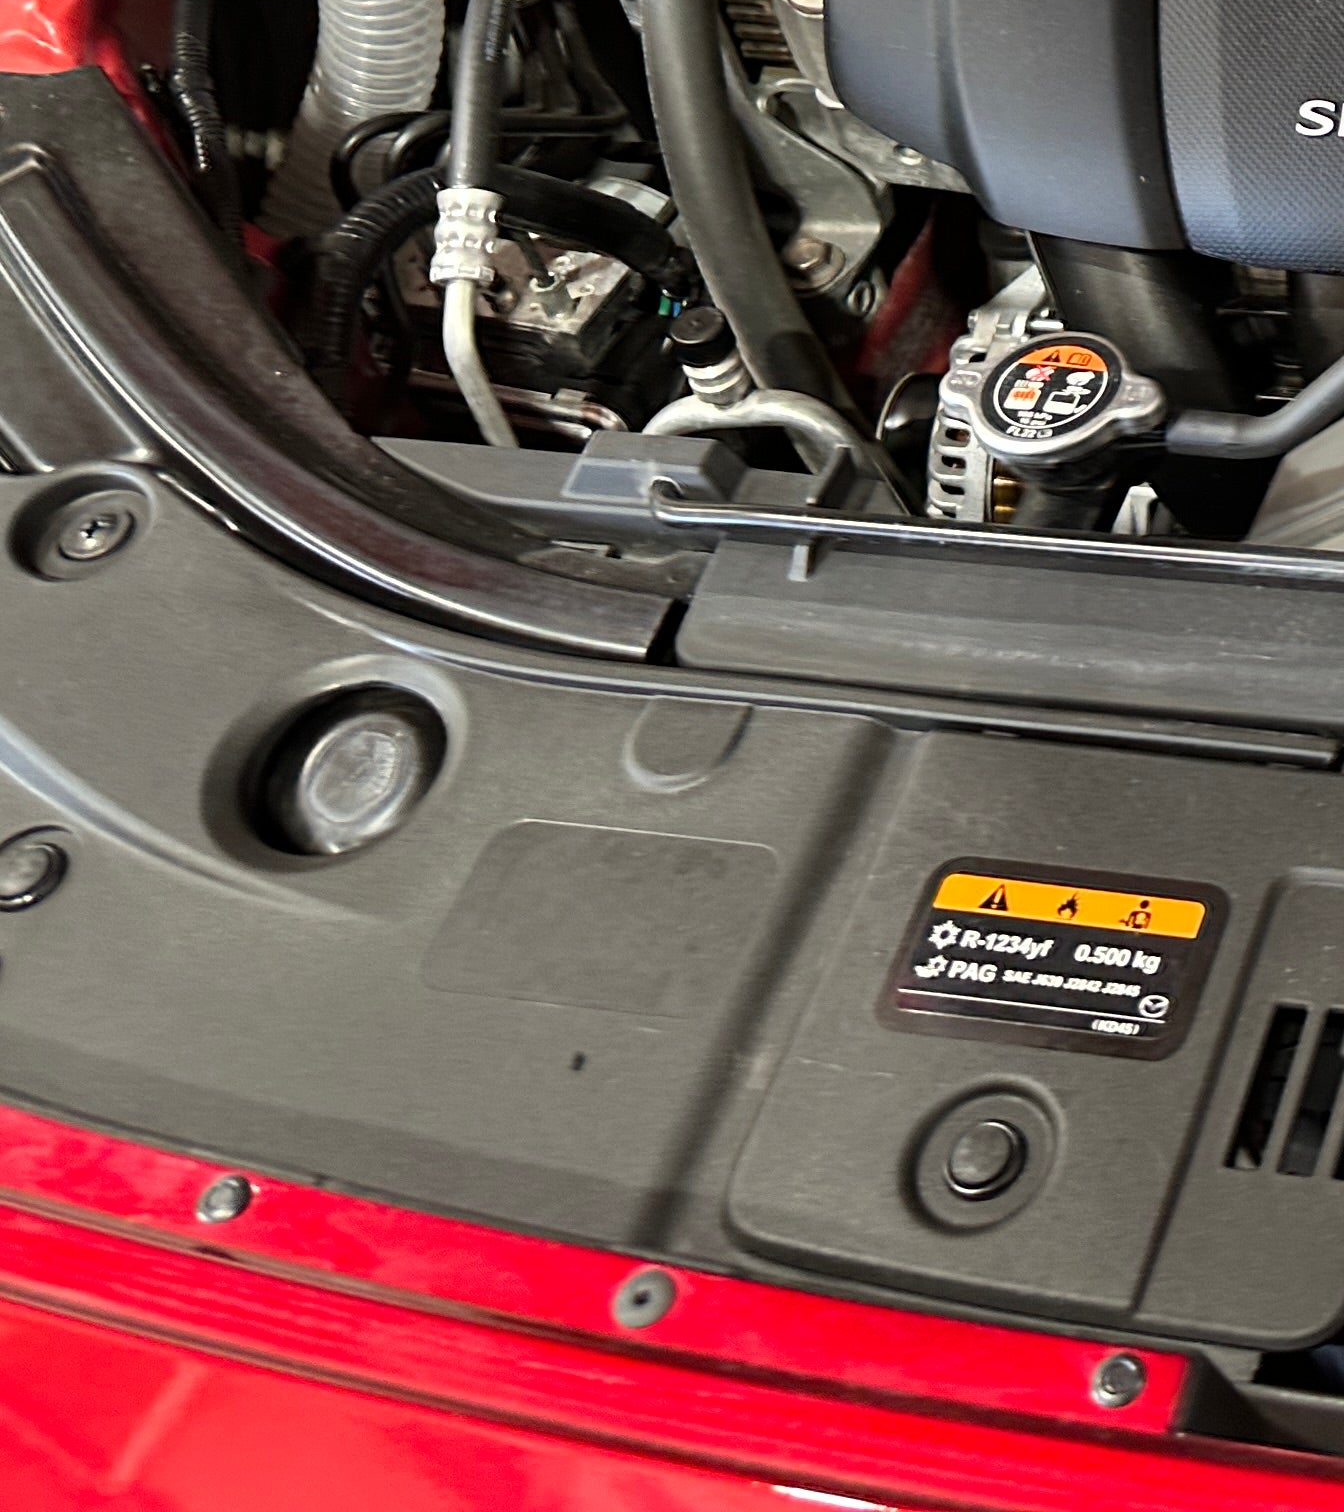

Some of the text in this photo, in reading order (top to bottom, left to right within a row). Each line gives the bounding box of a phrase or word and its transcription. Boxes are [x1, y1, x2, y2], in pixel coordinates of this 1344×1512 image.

[960, 930, 1162, 975] R-1234yf 0.500 kg
[948, 960, 998, 983] PAG
[1002, 969, 1033, 984] SAE
